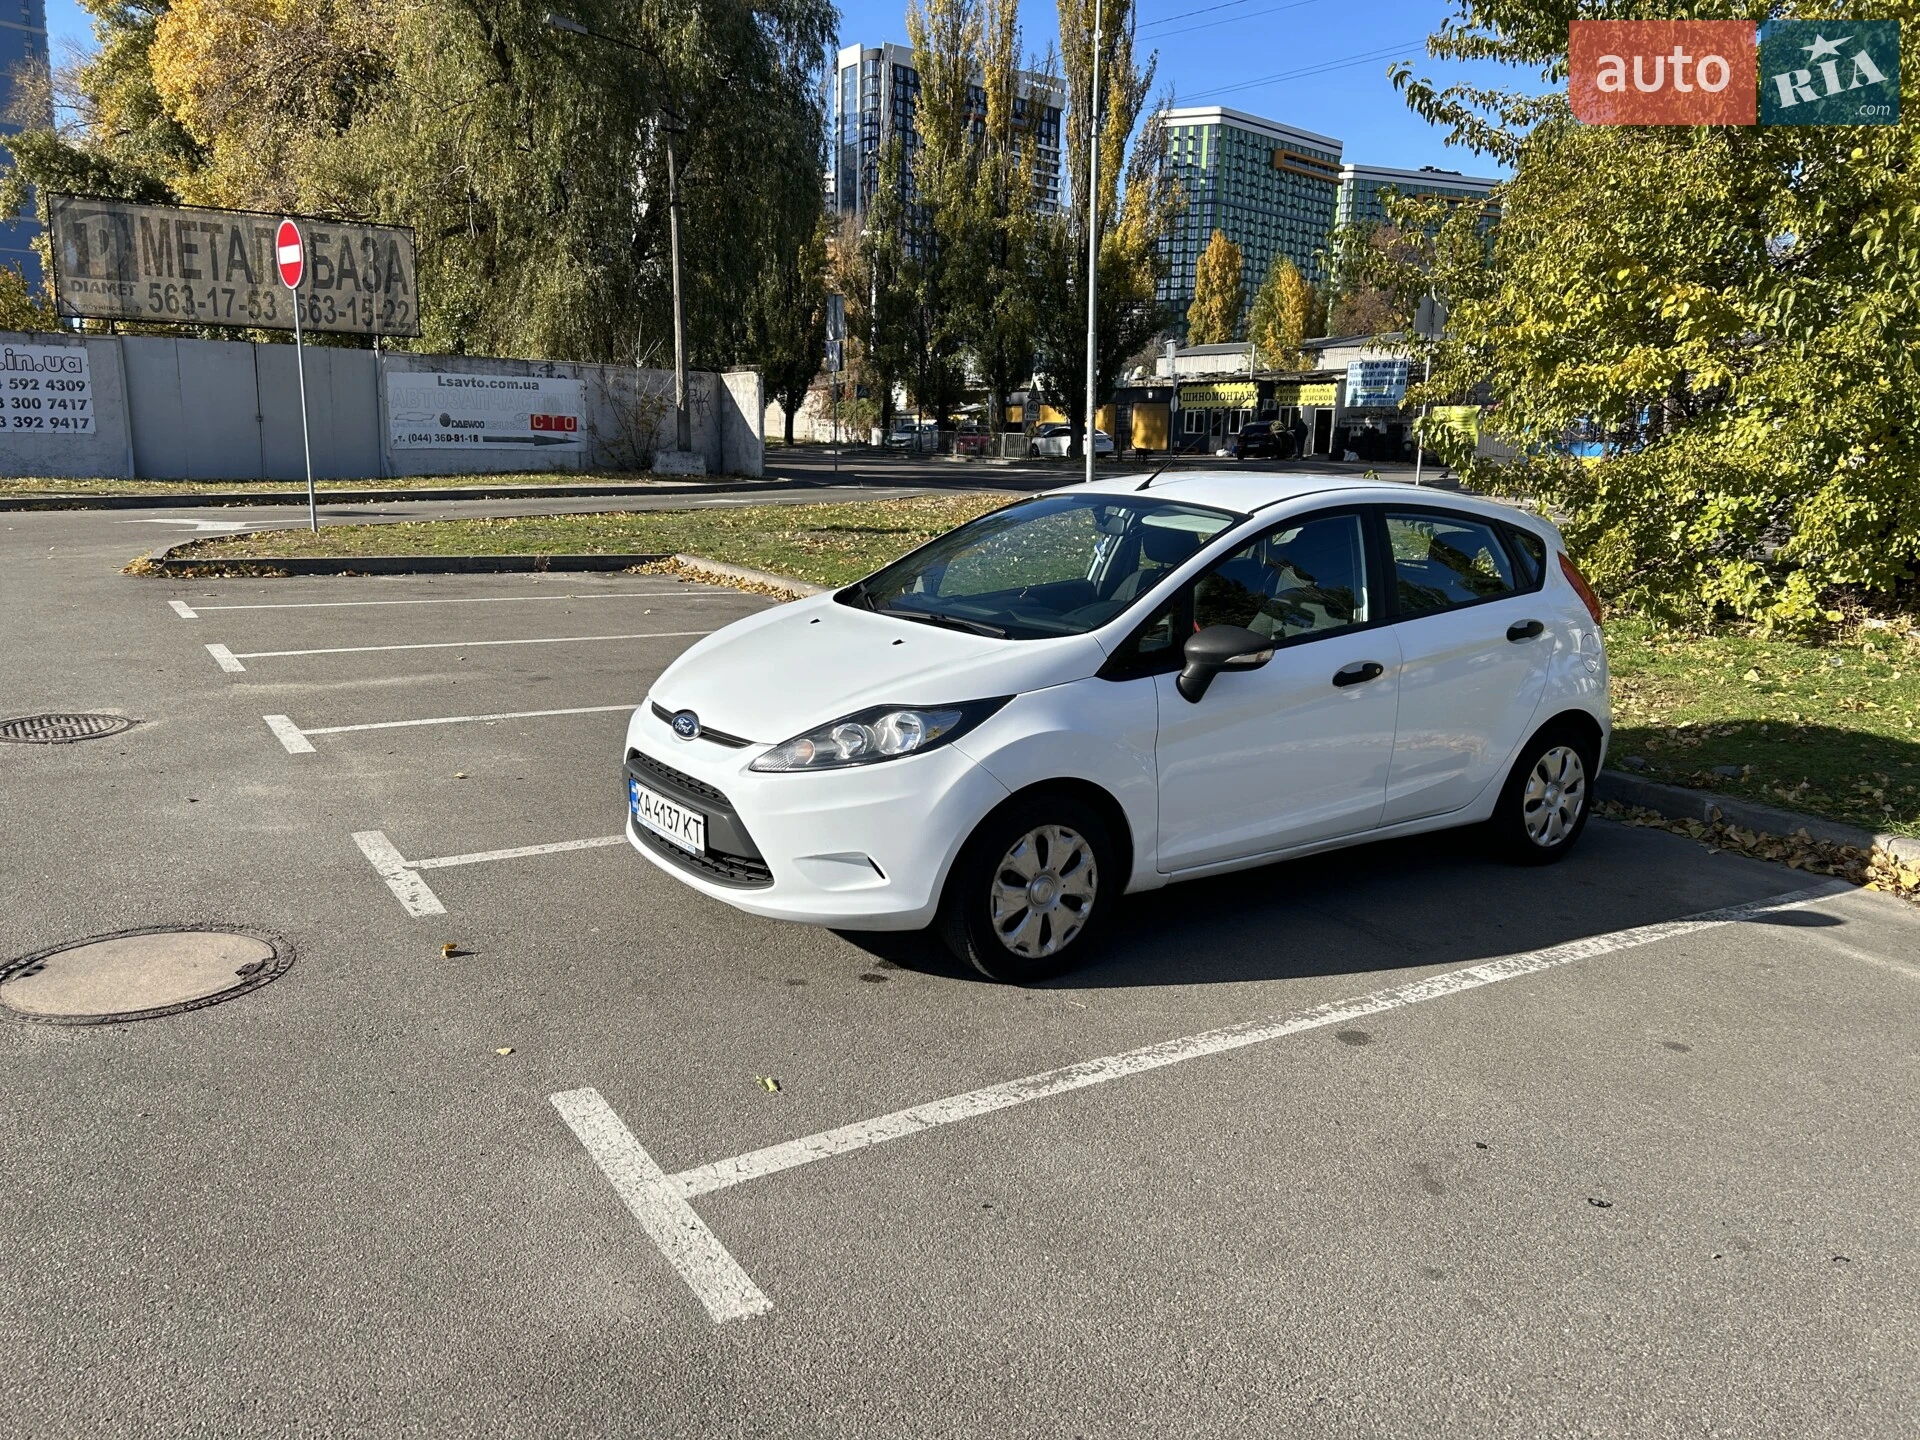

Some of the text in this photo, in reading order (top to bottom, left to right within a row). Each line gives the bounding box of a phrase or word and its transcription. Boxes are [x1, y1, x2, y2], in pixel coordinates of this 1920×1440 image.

[140, 215, 409, 296] МЕТАЛБАЗА
[70, 280, 136, 296] DIAMET
[148, 282, 411, 329] 563-17-53 563-15-22
[9, 378, 39, 390] 592
[45, 379, 85, 391] 4309
[437, 375, 539, 390] Lsavto.com.ua
[1182, 390, 1256, 402] ШИНОМОНТАЖ
[1304, 394, 1333, 402] ДИСКОВ
[11, 397, 41, 409] 300
[47, 398, 88, 410] 7417
[13, 416, 44, 428] 392
[49, 417, 90, 429] 9417
[451, 420, 485, 429] DAEWOO
[533, 414, 575, 431] СТО
[408, 433, 432, 444] (044)
[434, 433, 479, 442] 360-91-18
[637, 788, 652, 819] KA
[654, 800, 680, 833] 4137
[683, 814, 702, 844] KT
